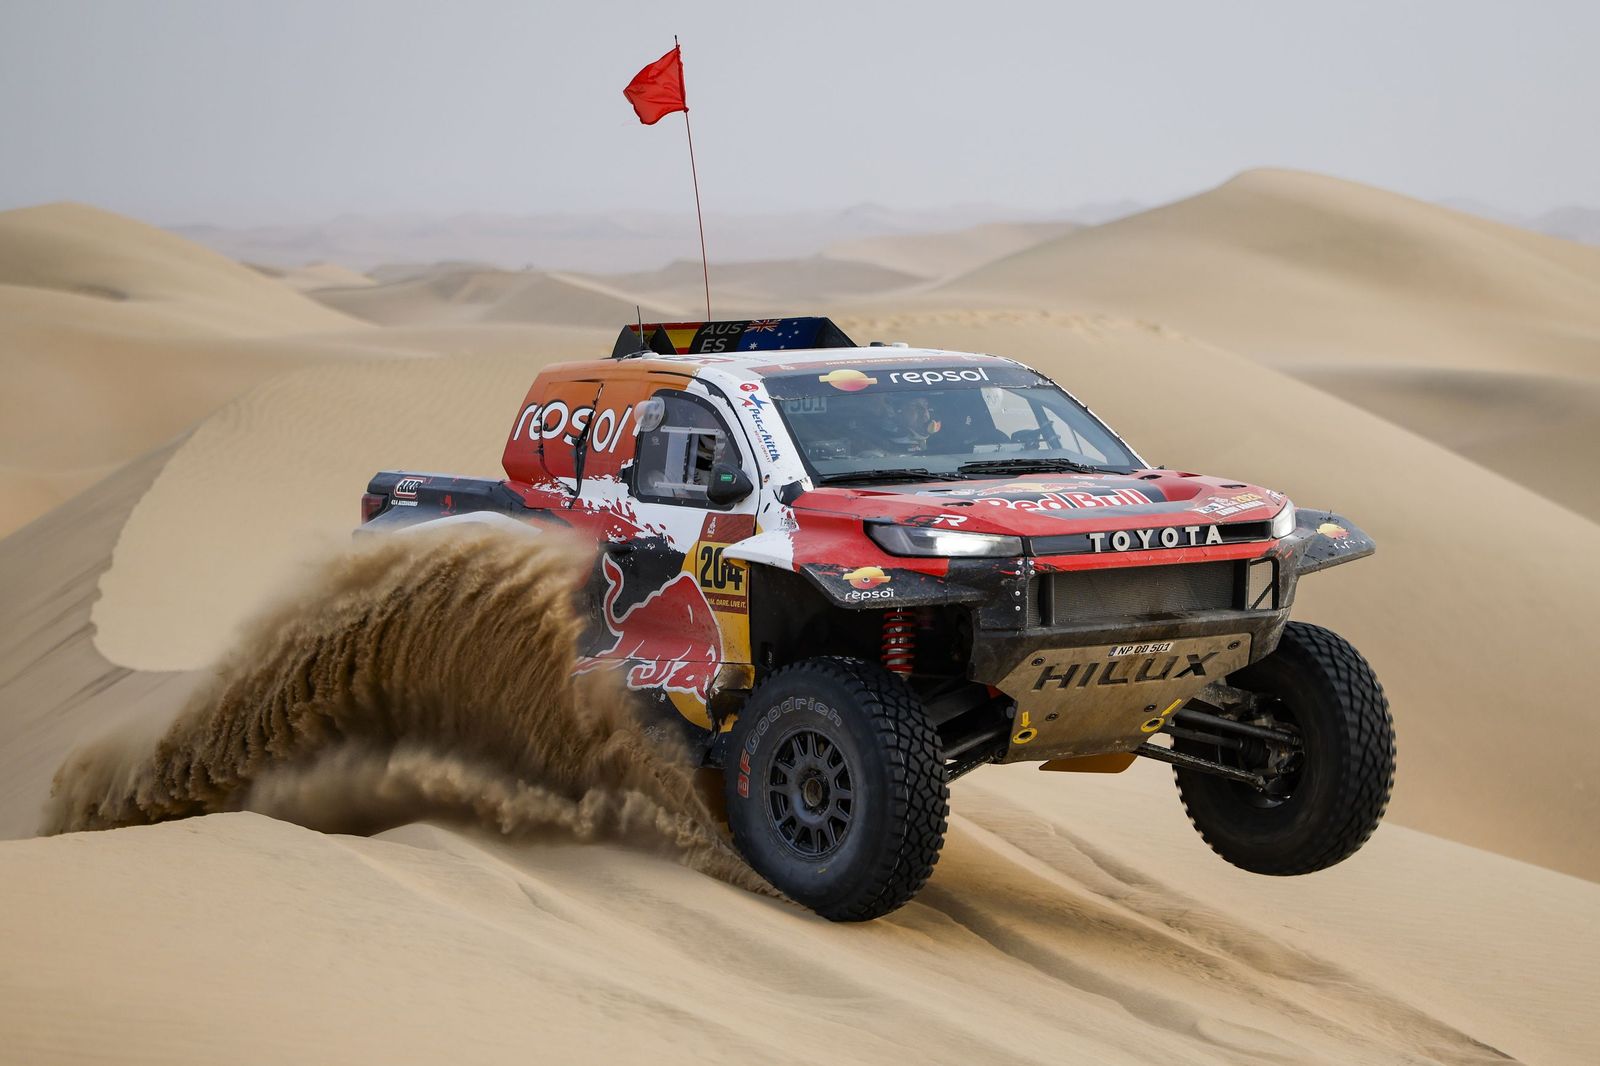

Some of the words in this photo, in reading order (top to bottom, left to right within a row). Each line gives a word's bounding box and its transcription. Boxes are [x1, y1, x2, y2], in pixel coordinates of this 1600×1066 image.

[701, 323, 744, 335] AUS
[700, 338, 728, 352] ES
[889, 367, 990, 386] repsol
[1089, 524, 1224, 553] TOYOTA
[700, 546, 743, 591] 204
[845, 588, 894, 601] repsol
[1117, 645, 1133, 655] NP
[1150, 643, 1171, 653] 501
[1031, 651, 1220, 692] HILUX
[737, 696, 843, 799] BFGoodrich
